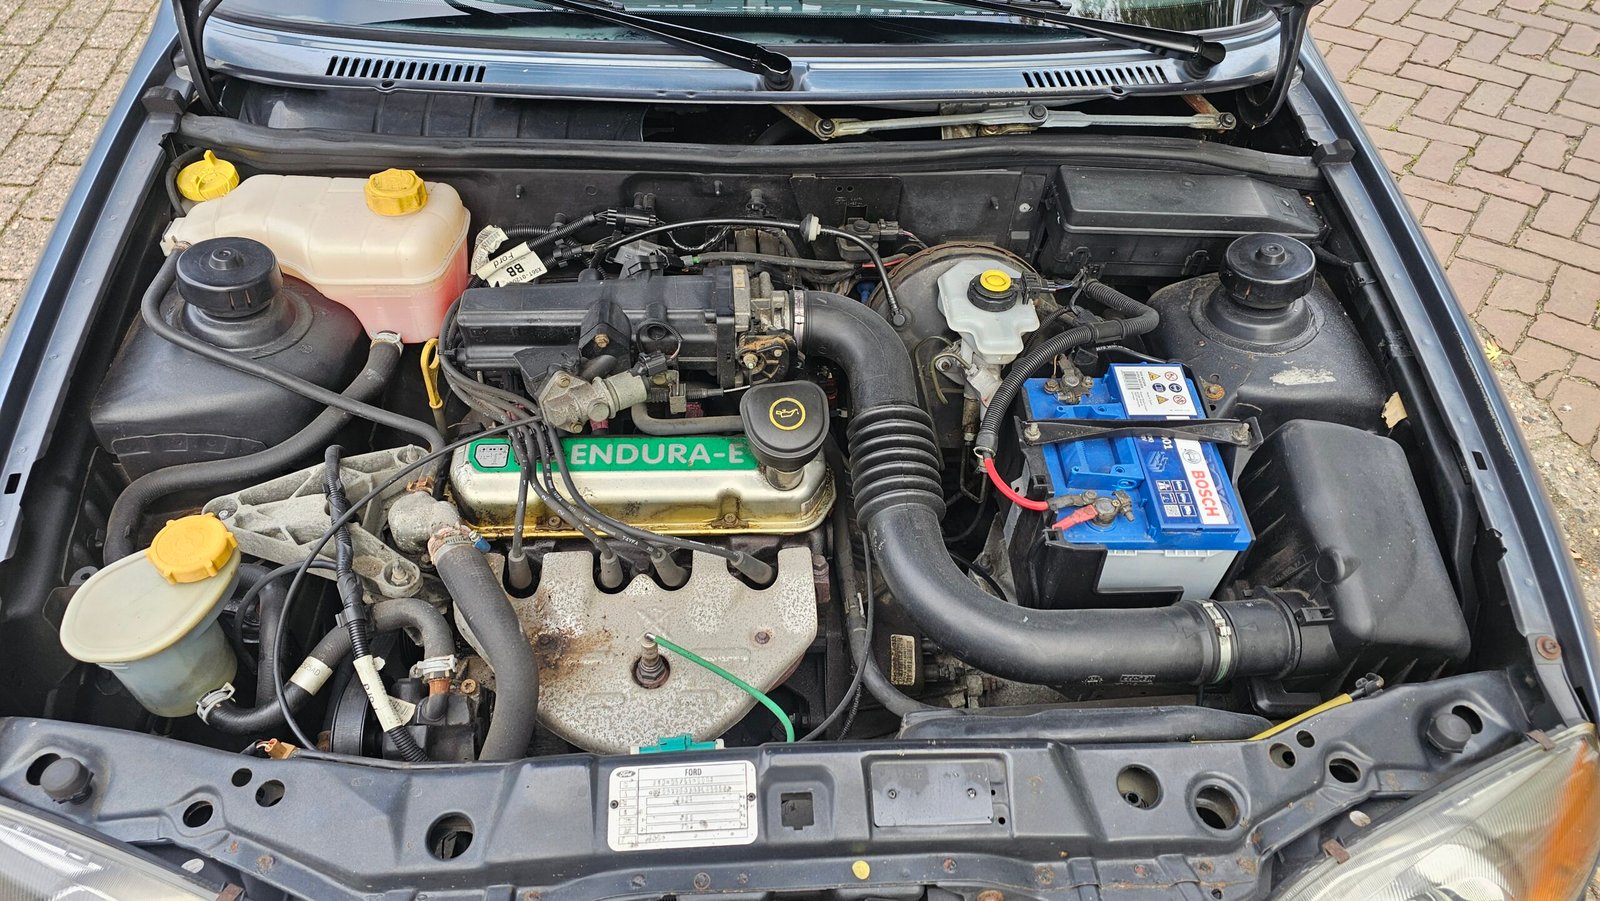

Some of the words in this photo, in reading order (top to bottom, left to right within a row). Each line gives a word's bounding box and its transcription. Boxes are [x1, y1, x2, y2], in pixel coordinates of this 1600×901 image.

[493, 252, 514, 269] Ford
[506, 263, 525, 277] BB
[570, 443, 743, 464] ENDURA-E
[1191, 470, 1220, 517] BOSCH
[684, 768, 702, 776] FORD
